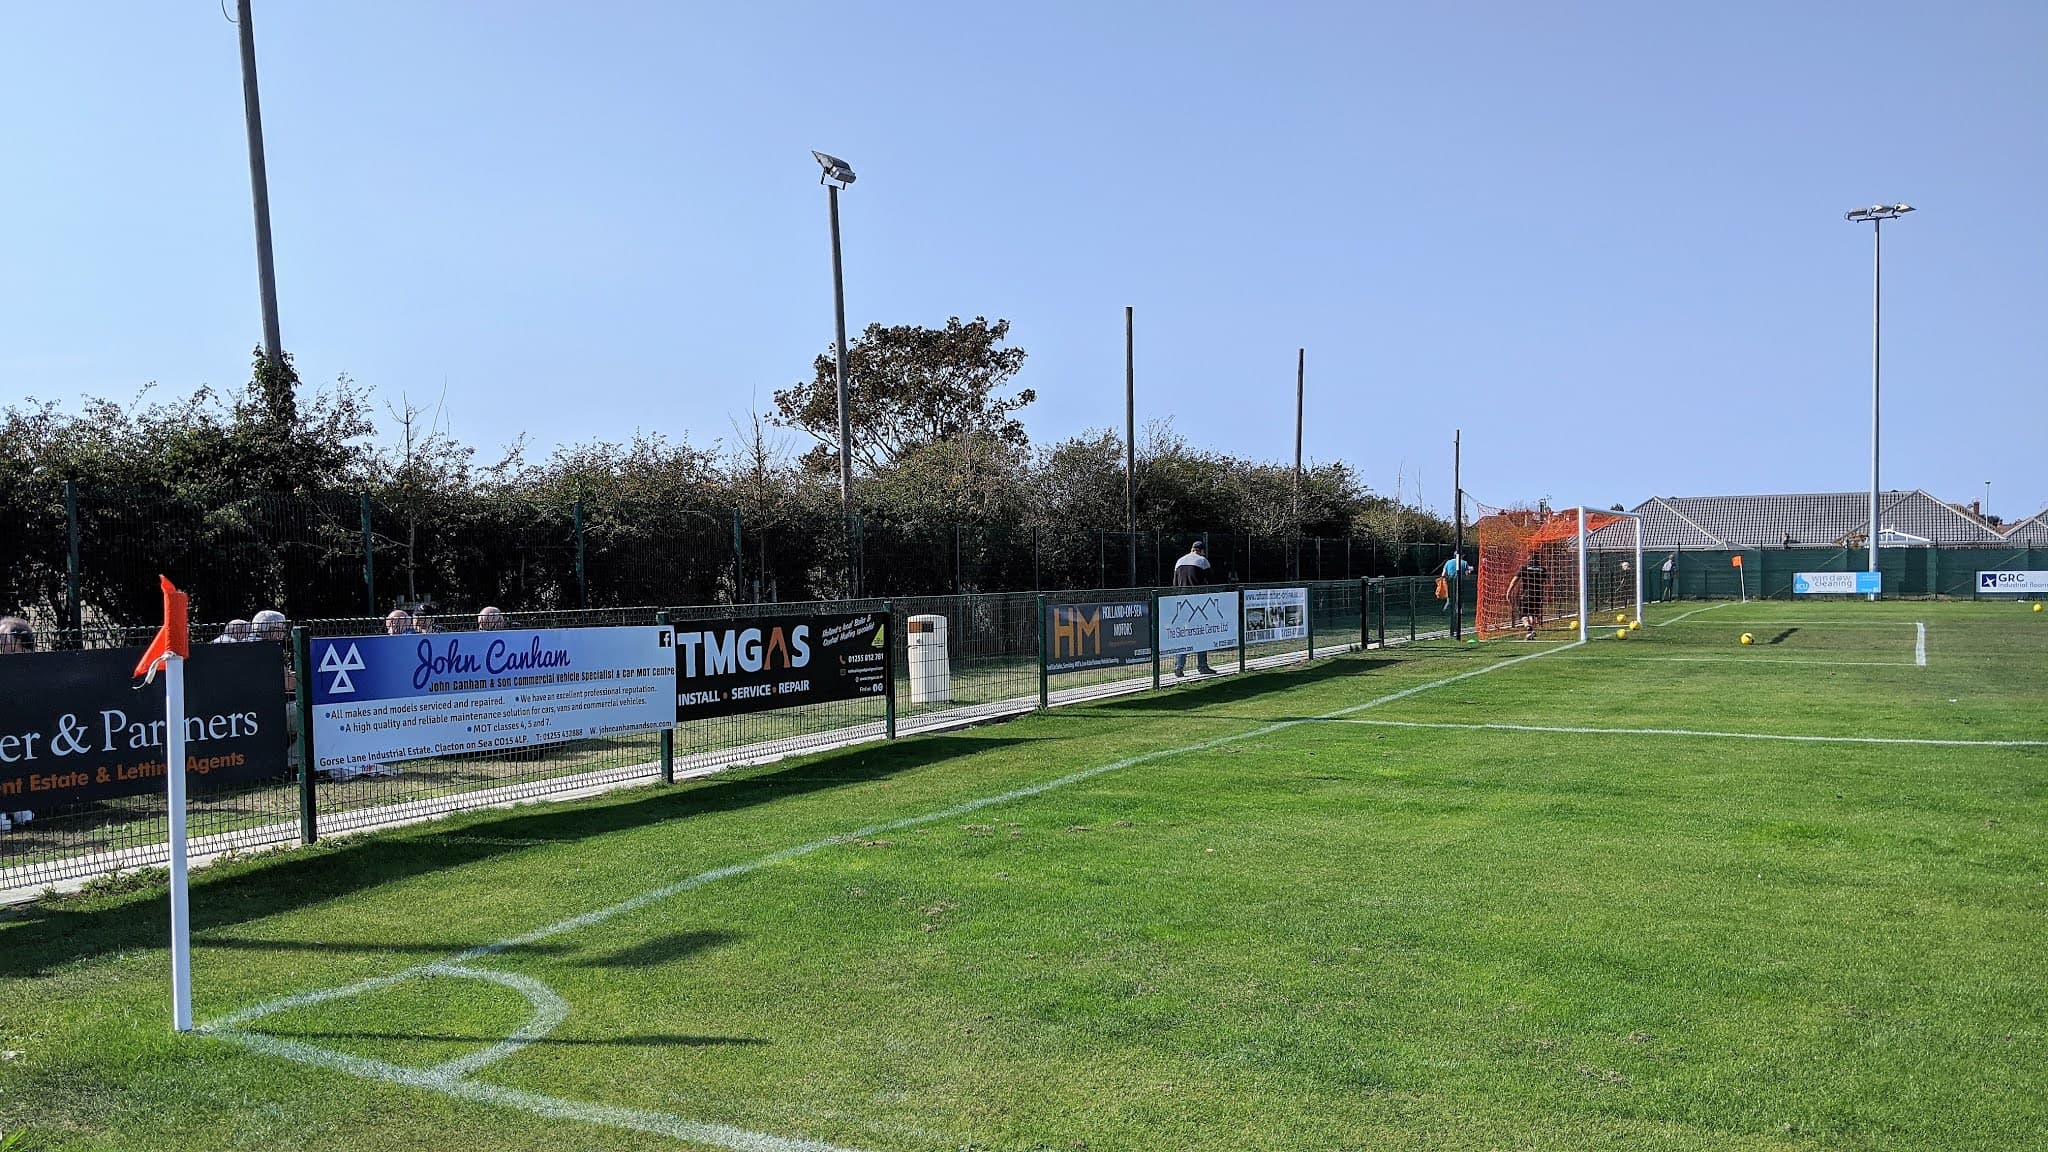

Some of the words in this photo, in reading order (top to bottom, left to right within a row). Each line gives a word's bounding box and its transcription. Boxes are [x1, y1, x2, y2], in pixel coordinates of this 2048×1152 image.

[1814, 580, 1852, 588] cleaning
[1998, 573, 2025, 582] GRC
[1053, 606, 1100, 659] HM
[413, 638, 481, 690] John
[485, 635, 571, 675] Canham
[677, 625, 810, 678] TMGAS
[429, 681, 450, 693] John
[490, 678, 495, 688] &
[636, 667, 650, 678] MOT
[678, 690, 720, 706] INSTALL
[731, 684, 772, 700] SERVICE
[779, 680, 810, 694] REPAIR
[520, 694, 531, 703] We
[532, 693, 547, 702] have
[584, 686, 621, 699] professional
[330, 710, 343, 720] All
[345, 708, 371, 719] makes
[373, 705, 388, 716] and
[390, 703, 418, 714] models
[419, 700, 452, 711] serviced
[453, 698, 469, 709] and
[471, 696, 505, 708] repaired.
[345, 723, 351, 733] A
[353, 721, 371, 733] high
[373, 719, 401, 732] quality
[402, 716, 417, 727] and
[418, 713, 448, 725] reliable
[450, 711, 503, 722] maintenance
[503, 707, 531, 718] solution
[531, 706, 541, 715] for
[541, 706, 556, 715] cars,
[571, 702, 583, 711] and
[583, 699, 619, 710] commercial
[51, 713, 91, 756] &
[100, 709, 259, 752] Parners
[473, 724, 492, 733] MOT
[493, 721, 520, 731] classes
[520, 721, 527, 730] 4,
[528, 720, 532, 728] 5
[533, 717, 545, 727] and
[543, 731, 561, 740] 01255
[320, 757, 345, 767] Gorse
[346, 754, 366, 764] Lane
[368, 748, 406, 761] Industrial
[434, 742, 465, 752] Clacton
[466, 741, 476, 749] on
[478, 739, 493, 748] Sea
[494, 737, 514, 746] CO15
[30, 771, 89, 792] Estate
[96, 767, 111, 784] &
[117, 760, 168, 781] Lettin
[186, 751, 245, 775] Agents
